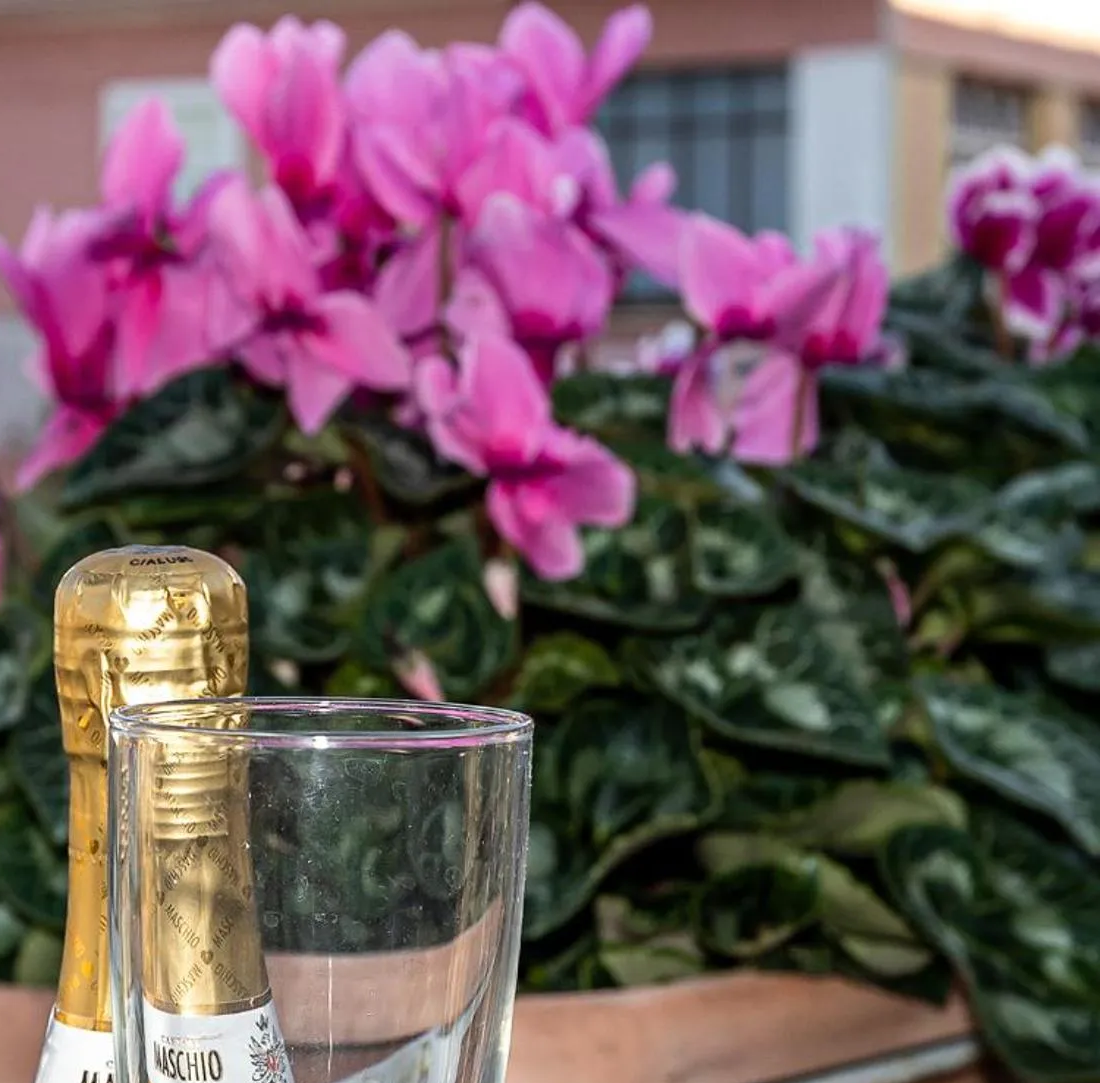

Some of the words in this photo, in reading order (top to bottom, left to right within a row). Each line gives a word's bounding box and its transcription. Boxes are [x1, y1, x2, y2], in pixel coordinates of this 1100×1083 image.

[164, 904, 200, 948] MASCHIO
[212, 914, 236, 949] MASC
[214, 963, 247, 999] ASCHIO
[153, 1041, 223, 1082] MASCHIO
